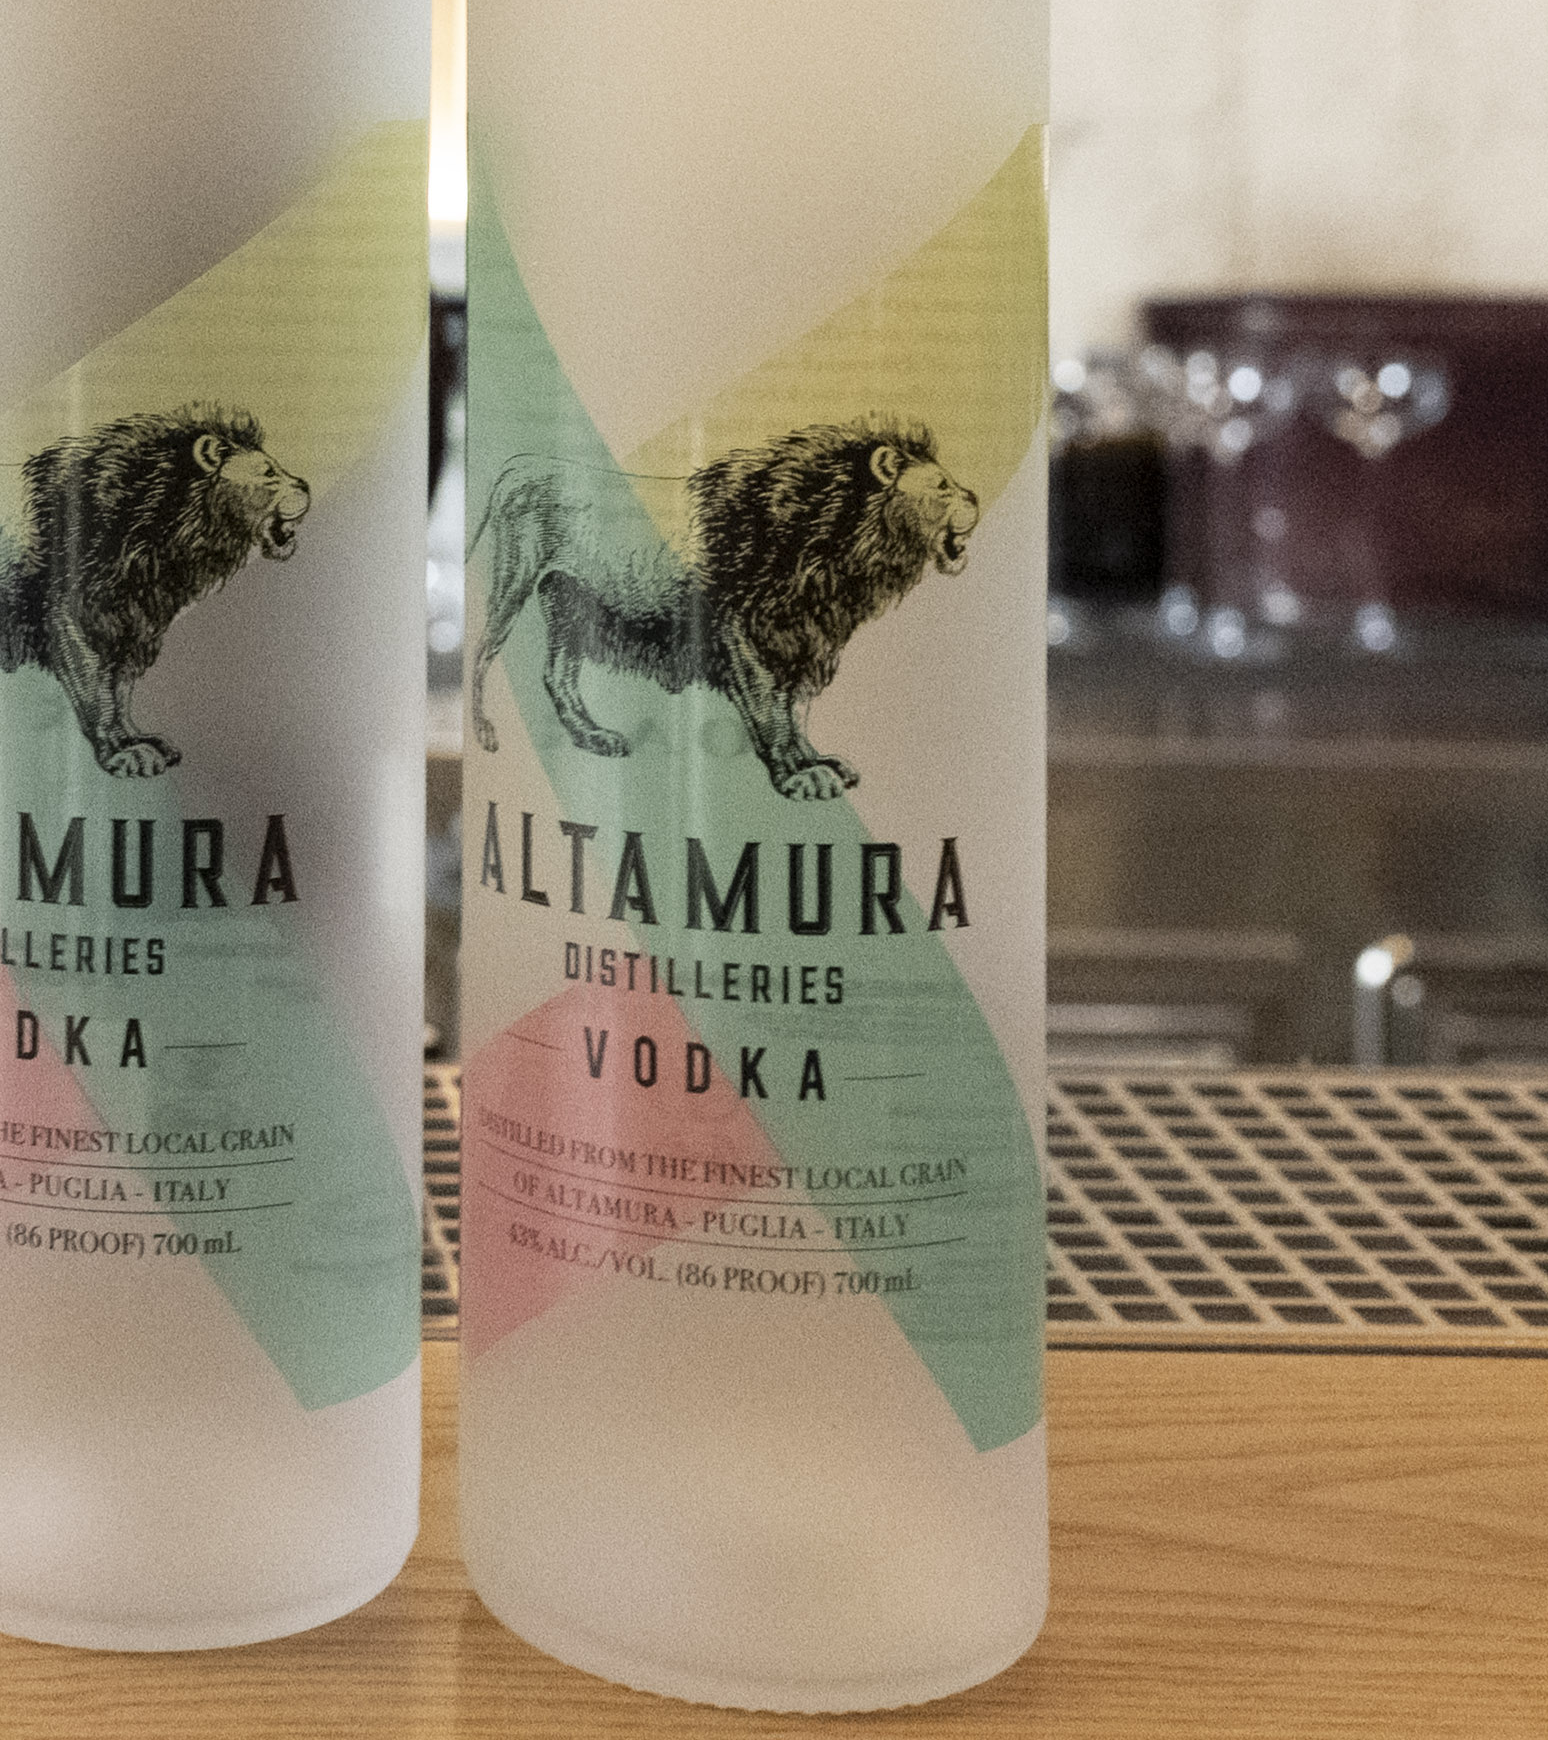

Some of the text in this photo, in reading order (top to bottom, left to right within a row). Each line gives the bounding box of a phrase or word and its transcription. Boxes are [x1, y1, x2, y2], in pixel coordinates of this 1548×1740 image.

[480, 800, 970, 936] ALTAMURA
[565, 942, 844, 1004] DISTILLERIES
[585, 1026, 826, 1101] VODKA
[31, 1125, 120, 1153] FINEST
[126, 1131, 216, 1155] LOCAL
[220, 1123, 295, 1153] GRAIN
[571, 1139, 636, 1174] FROM
[641, 1153, 697, 1182] THE
[704, 1161, 799, 1190] FINEST
[806, 1166, 894, 1190] LOCAL
[899, 1158, 968, 1187] GRAIN
[29, 1172, 127, 1202] PUGLIA
[154, 1177, 231, 1202] ITALY
[513, 1171, 540, 1197] OF
[547, 1184, 678, 1230] ALTAMURA
[703, 1210, 806, 1240] PUGLIA
[834, 1213, 909, 1240] ITALY
[6, 1222, 42, 1250] (86
[48, 1227, 145, 1260] PROOF)
[153, 1232, 198, 1256] 700
[204, 1230, 241, 1255] mL
[677, 1261, 717, 1288] (86
[724, 1266, 826, 1298] PROOF)
[833, 1269, 880, 1295] 700
[884, 1267, 921, 1293] mL
